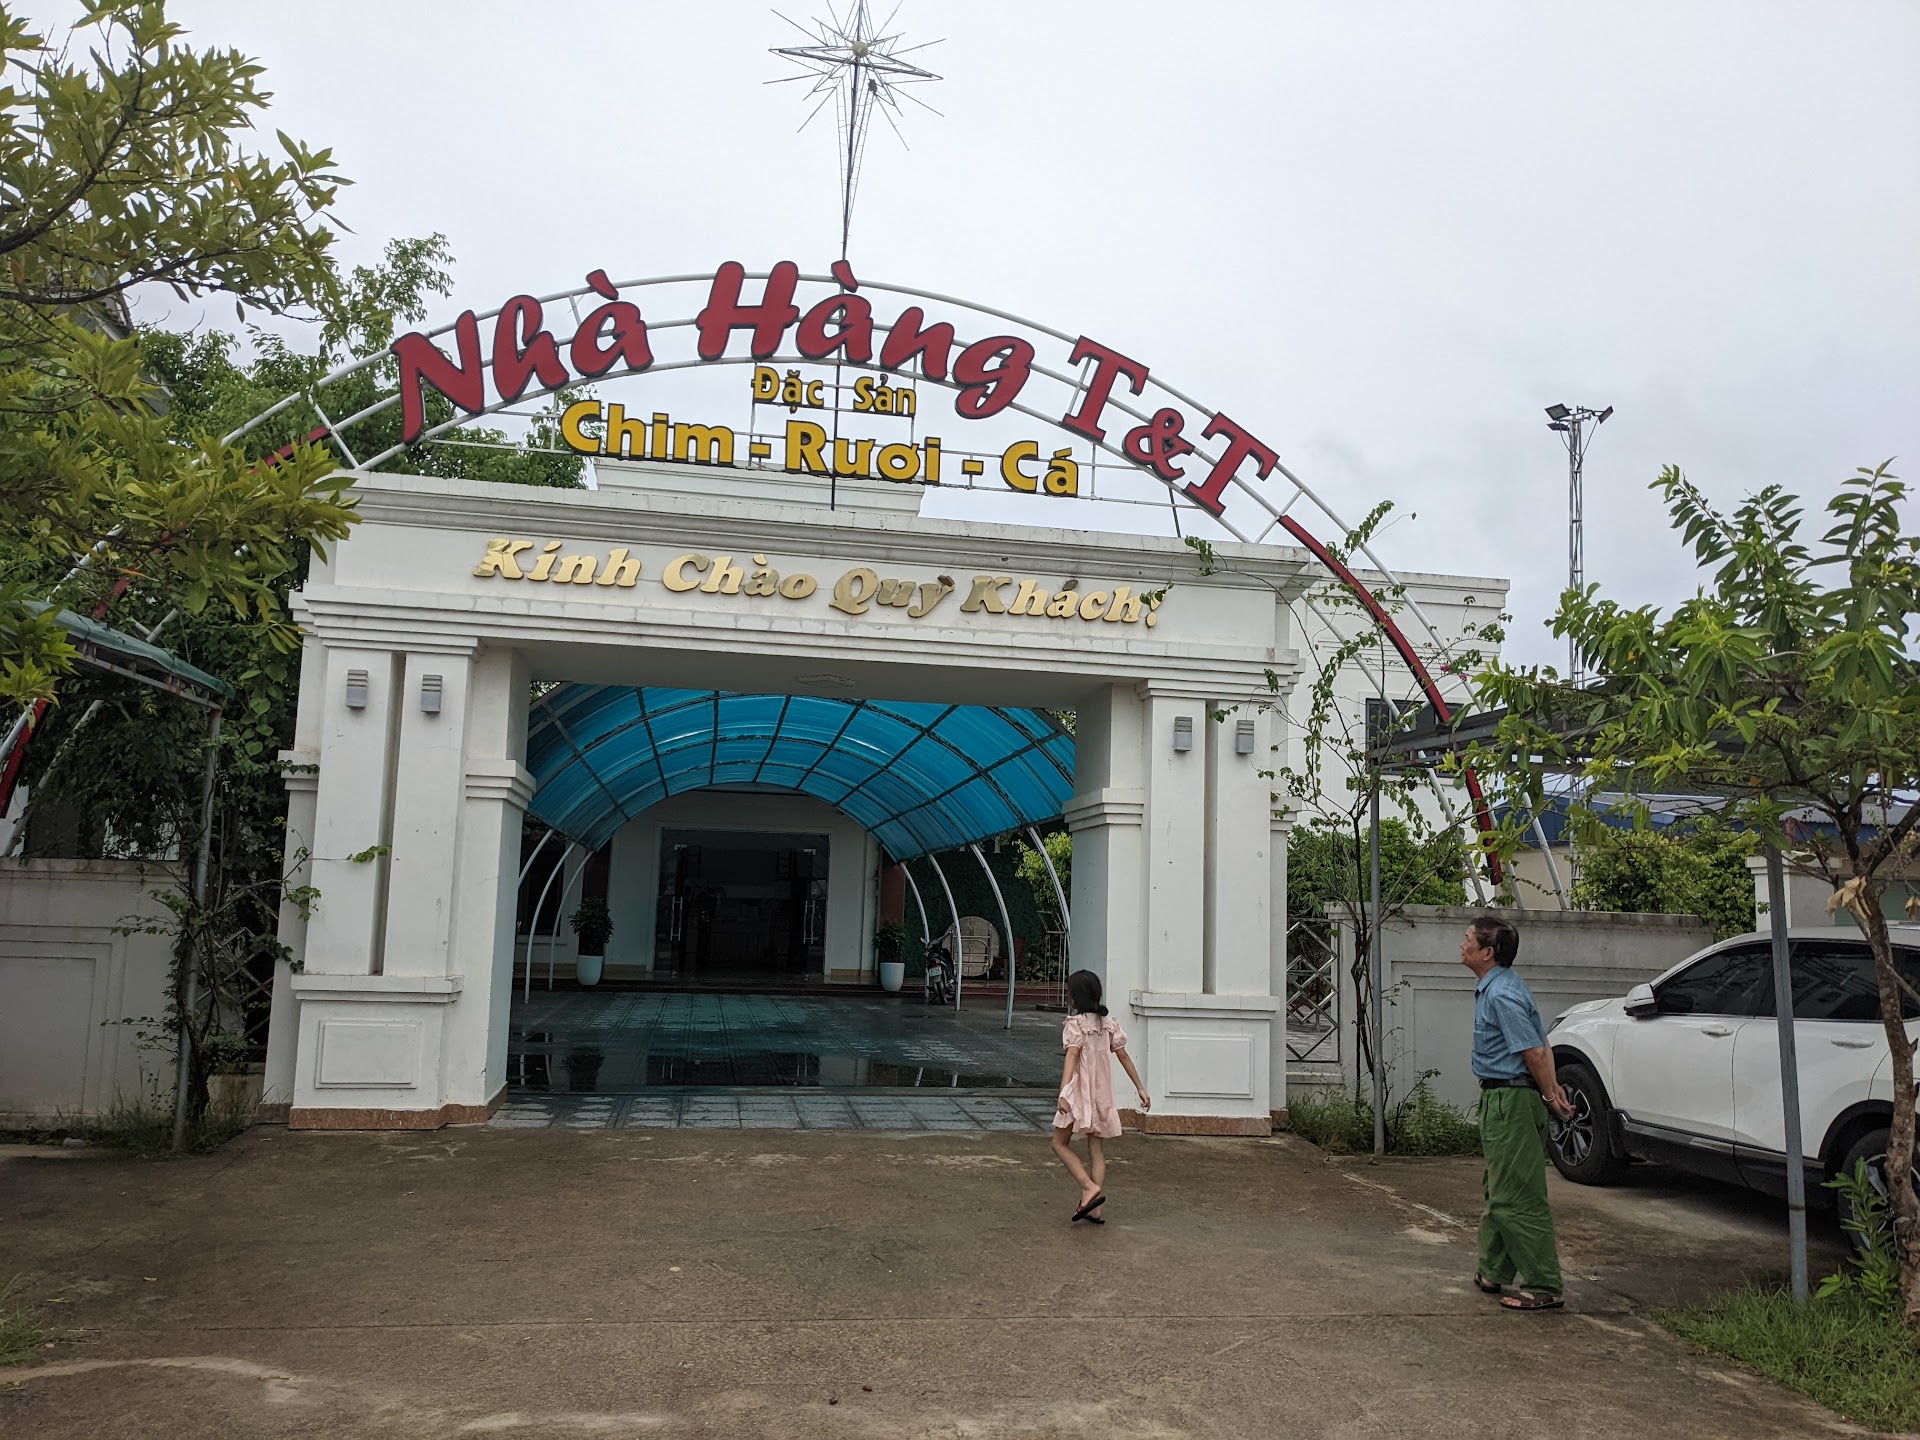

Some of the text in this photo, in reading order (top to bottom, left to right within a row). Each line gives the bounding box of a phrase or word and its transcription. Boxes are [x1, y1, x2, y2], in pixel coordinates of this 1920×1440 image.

[390, 260, 1280, 518] Nhà Hàng T&T
[751, 365, 916, 416] Đặc Sản
[561, 399, 734, 468] Chim
[785, 419, 941, 486] Rươi
[1000, 440, 1079, 497] Cá
[473, 538, 641, 587] Kính
[662, 553, 817, 600] Chào
